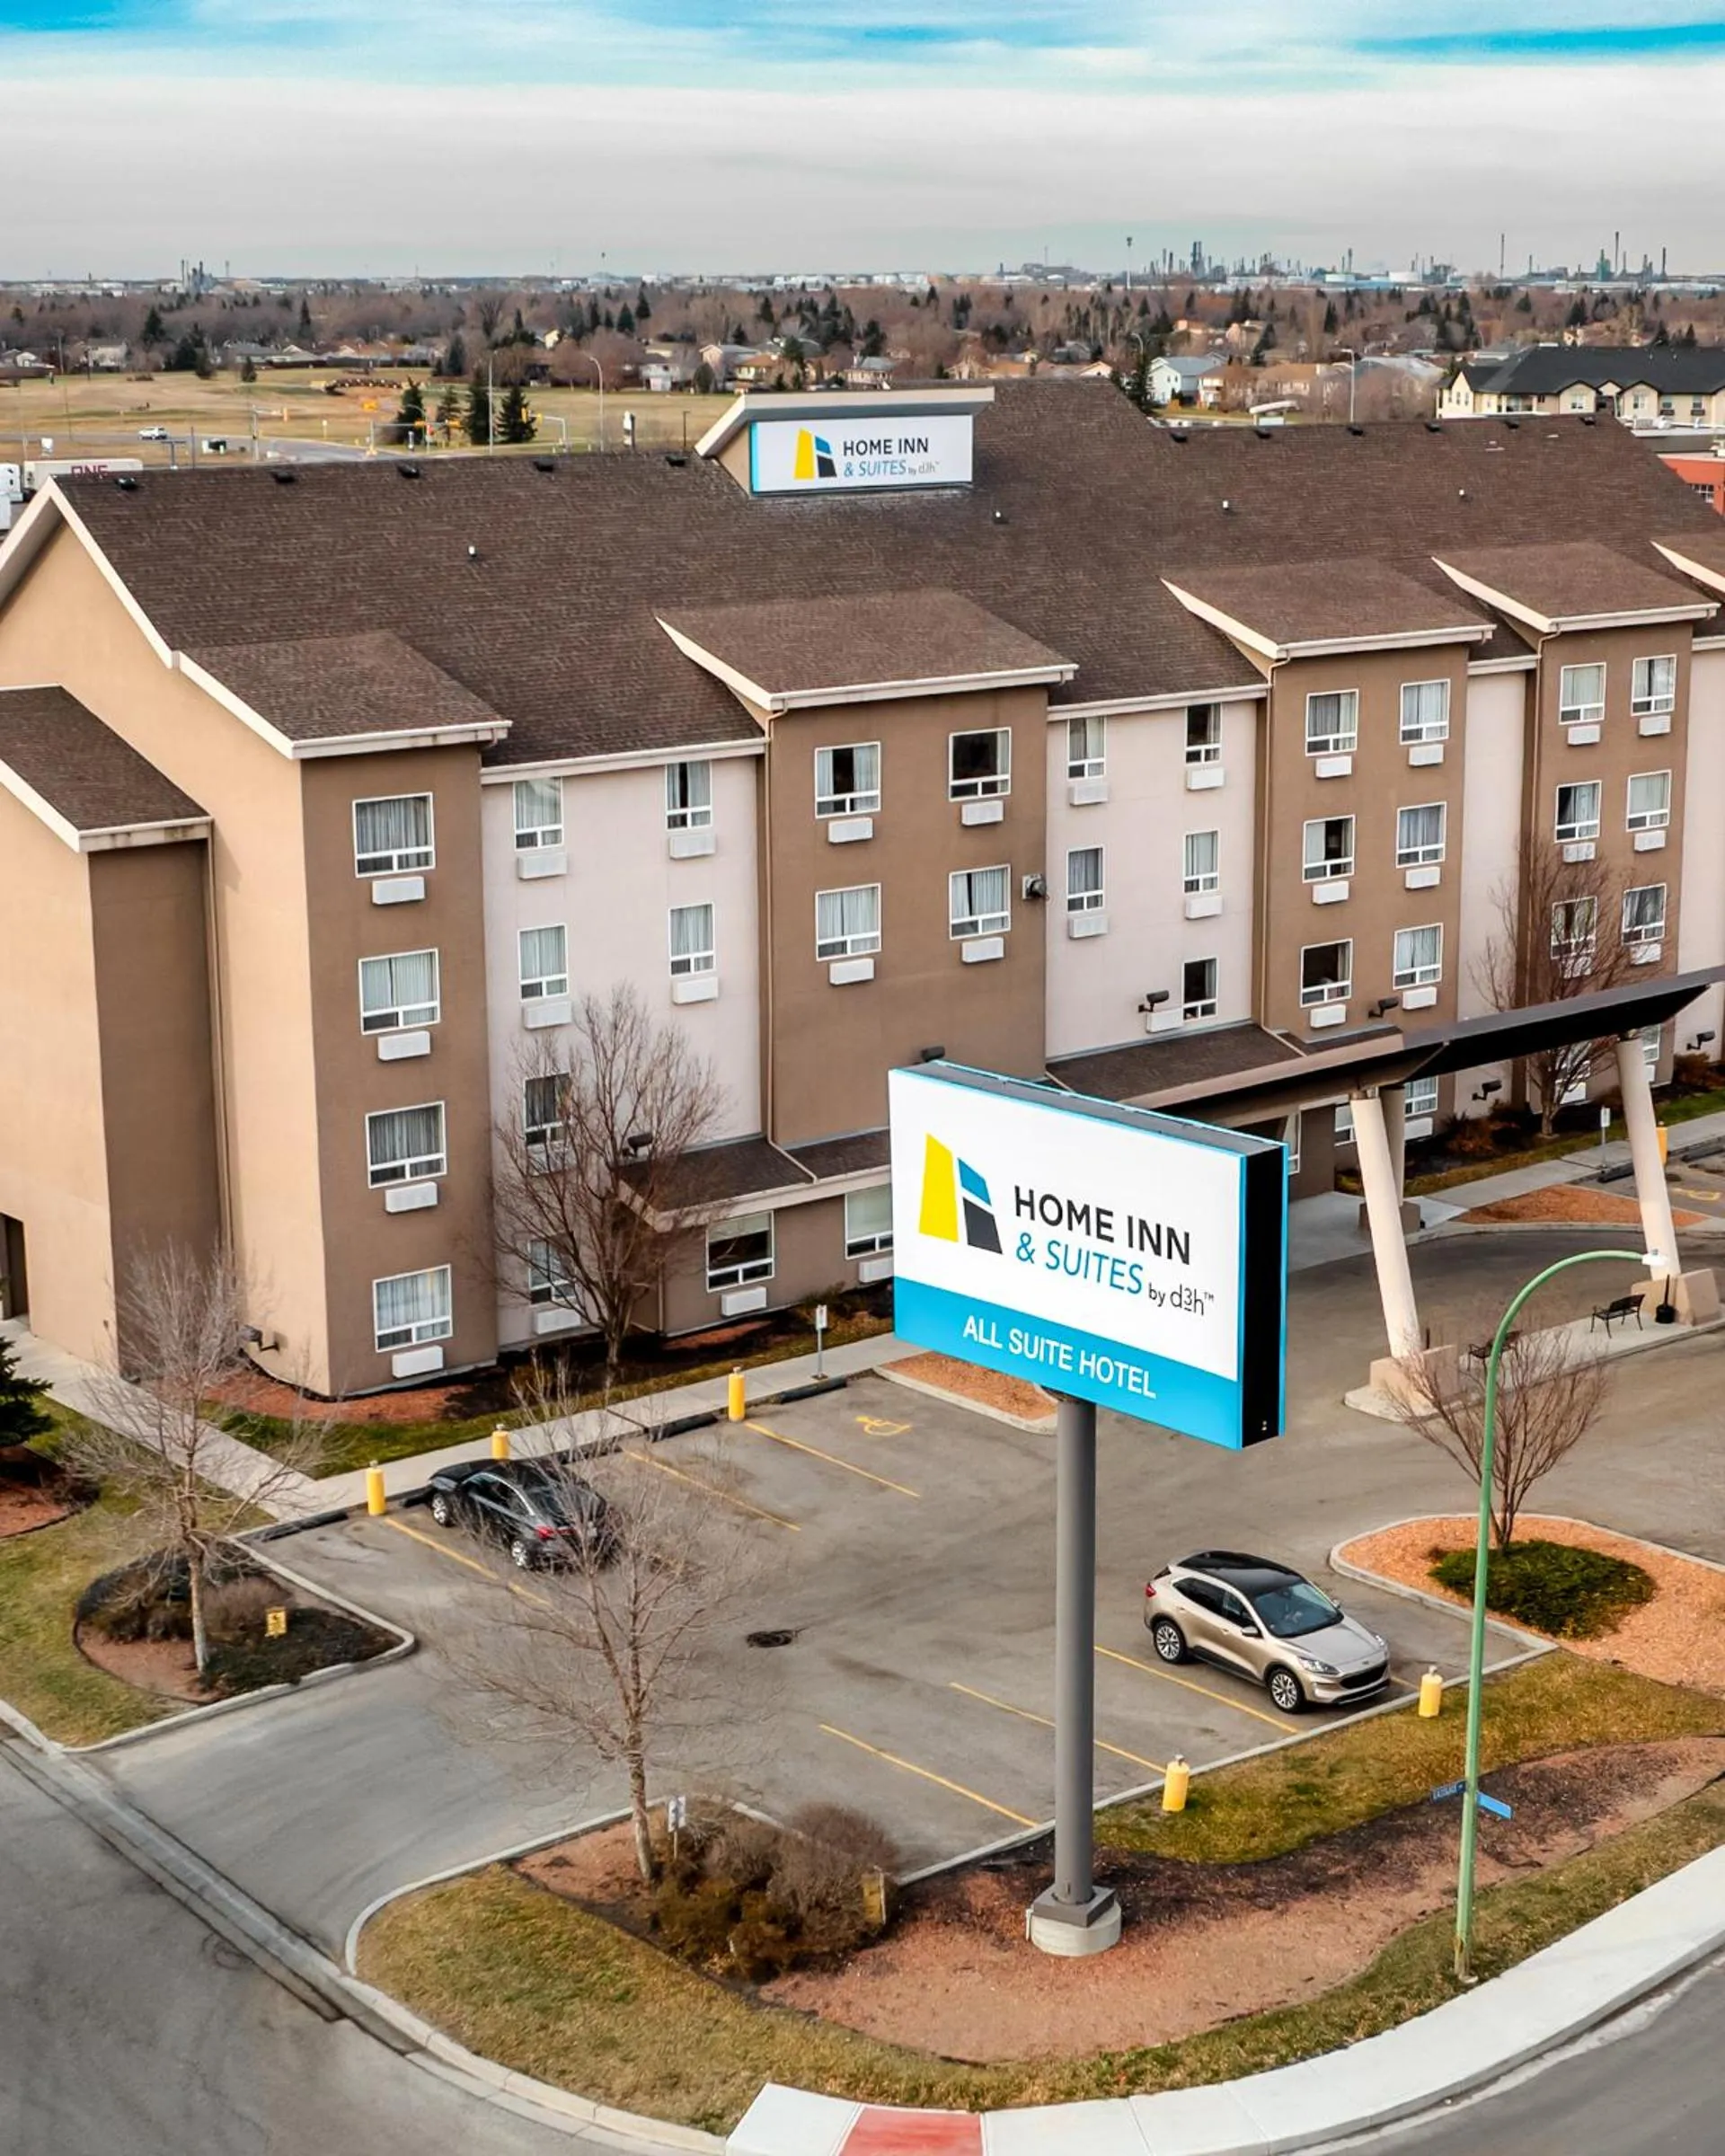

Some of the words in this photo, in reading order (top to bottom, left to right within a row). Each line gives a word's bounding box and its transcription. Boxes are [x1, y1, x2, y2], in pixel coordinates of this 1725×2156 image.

[843, 438, 893, 456] HOME
[898, 437, 929, 455] INN
[843, 461, 854, 478] &
[857, 459, 907, 477] SUITES
[1014, 1184, 1115, 1243] HOME
[1127, 1215, 1190, 1266] INN
[1015, 1232, 1036, 1265] &
[1045, 1239, 1144, 1294] SUITES
[1148, 1281, 1166, 1308] by
[962, 1314, 1004, 1349] ALL
[1007, 1327, 1074, 1372] SUITE
[1078, 1348, 1157, 1400] HOTEL
